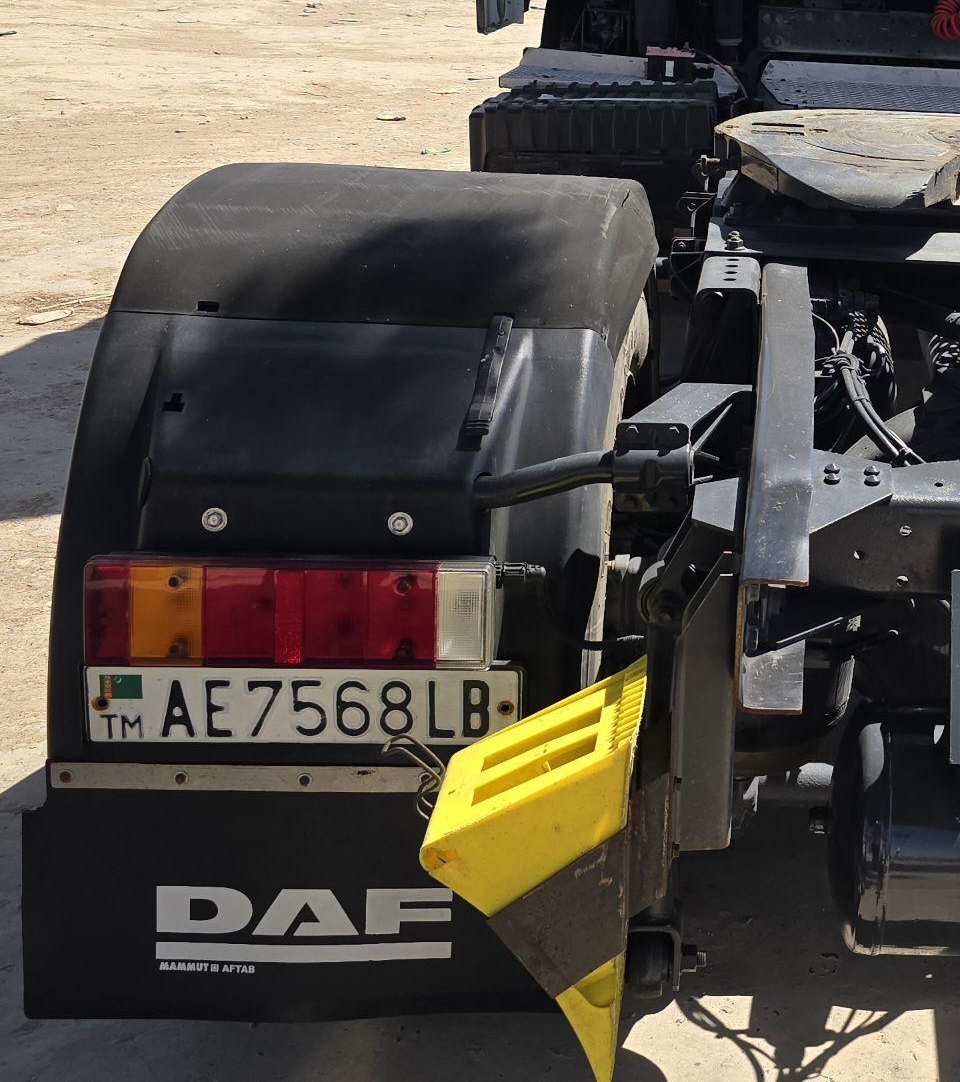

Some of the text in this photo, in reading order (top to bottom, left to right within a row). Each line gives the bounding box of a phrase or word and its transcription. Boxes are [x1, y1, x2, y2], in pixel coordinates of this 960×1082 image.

[99, 713, 144, 739] TM
[161, 678, 490, 739] AE7568LB
[155, 885, 454, 936] DAF
[159, 961, 256, 974] MAMMUT AFTAB
